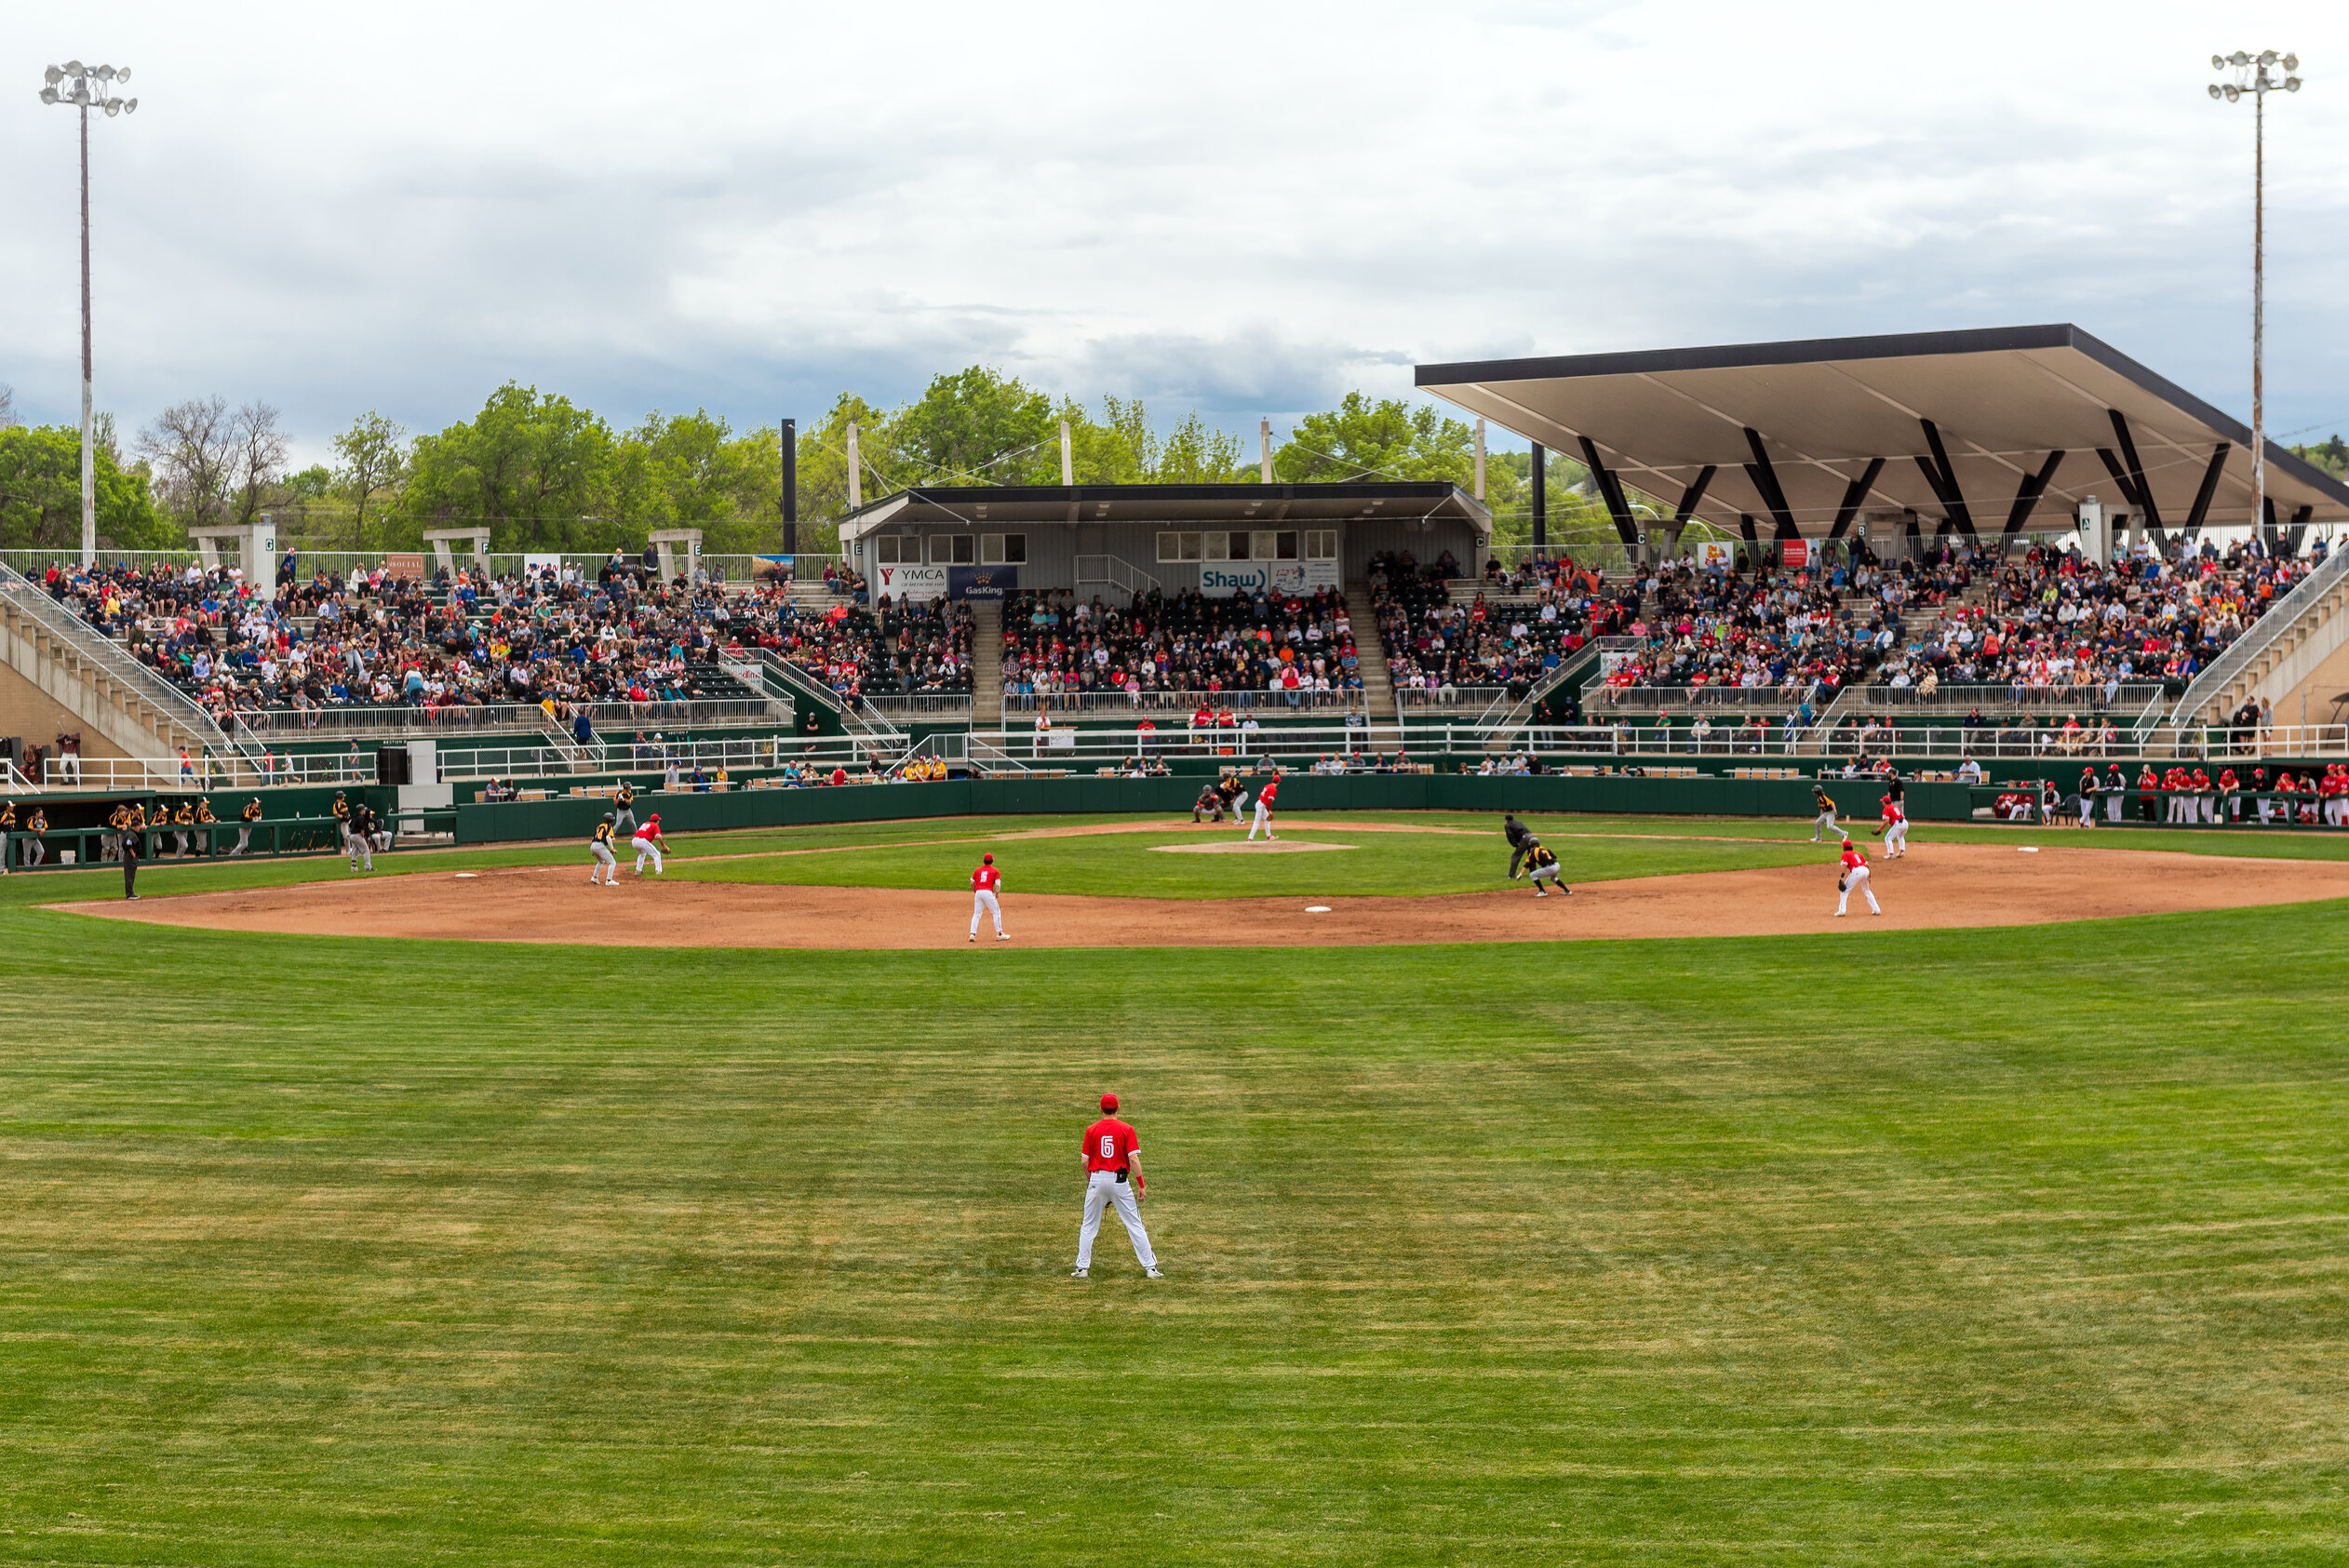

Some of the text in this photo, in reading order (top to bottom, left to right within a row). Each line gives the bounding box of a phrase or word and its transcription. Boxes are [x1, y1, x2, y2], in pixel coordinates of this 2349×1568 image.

[2083, 518, 2090, 530] A
[1859, 526, 1865, 536] B
[1476, 538, 1483, 547] C
[1638, 534, 1645, 544] C
[266, 540, 274, 550] G
[482, 543, 489, 554] F
[855, 545, 862, 555] E
[695, 545, 702, 556] E
[902, 569, 945, 580] YMCA
[1202, 570, 1256, 587] Shaw
[965, 586, 1003, 596] GasKing
[1101, 1135, 1114, 1159] 6
